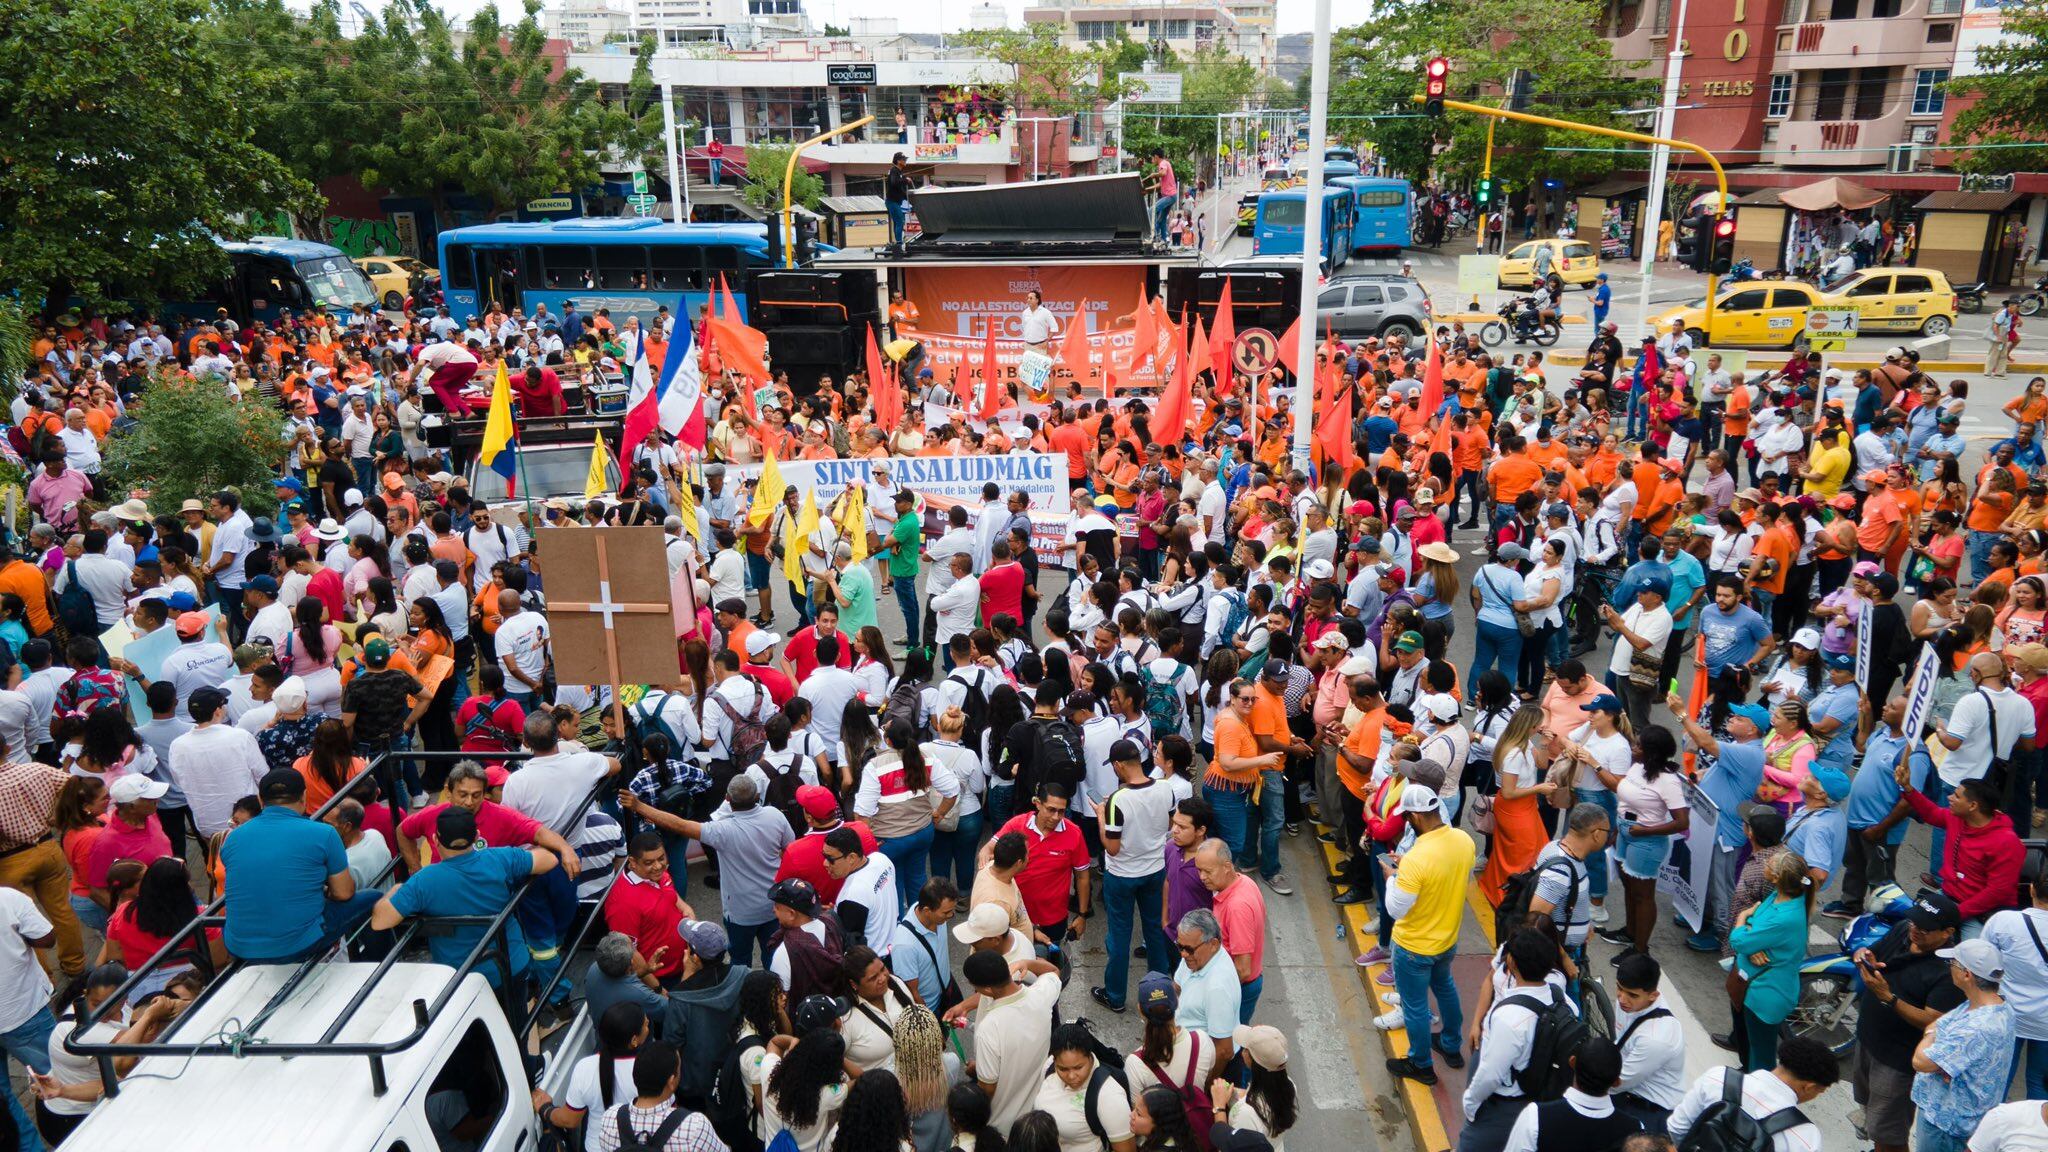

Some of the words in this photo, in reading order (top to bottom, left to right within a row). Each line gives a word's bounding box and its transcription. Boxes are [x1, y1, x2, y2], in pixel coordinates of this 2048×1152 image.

[832, 71, 872, 81] COQUETAS
[1703, 80, 1754, 97] TELAS
[942, 301, 960, 311] NO
[961, 301, 971, 311] A
[972, 301, 987, 311] LA
[1091, 301, 1109, 311] DE
[936, 352, 950, 364] el
[945, 484, 956, 495] de
[1036, 524, 1067, 535] Santa
[1906, 653, 1935, 739] ADED
